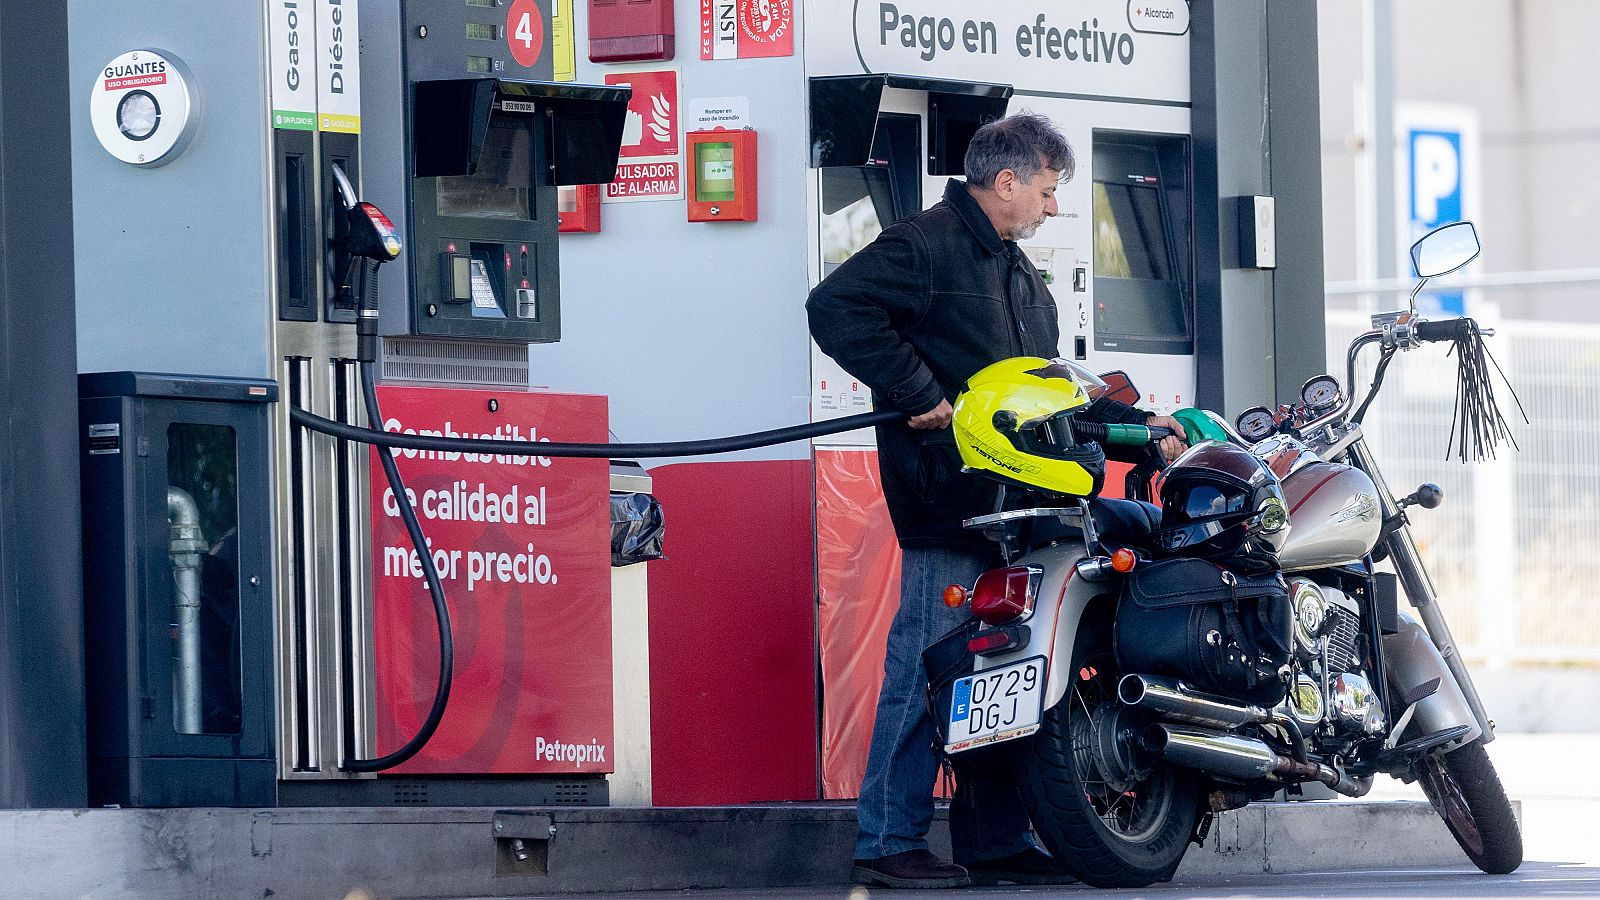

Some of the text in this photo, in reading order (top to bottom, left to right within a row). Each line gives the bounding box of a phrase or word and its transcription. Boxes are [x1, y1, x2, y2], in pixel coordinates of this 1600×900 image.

[515, 12, 533, 48] 4
[703, 0, 710, 54] 21 31 32
[720, 4, 735, 45] NST
[740, 12, 760, 42] SEGURIDAD
[768, 0, 790, 41] ECTADA
[770, 3, 780, 20] 24H
[1144, 7, 1174, 19] Alcorcón
[284, 2, 300, 92] Gasol
[329, 0, 344, 94] Diésel
[879, 3, 1135, 66] Pago en efectivo
[104, 61, 166, 78] GUANTES
[107, 76, 163, 88] USO OBLIGATORIO
[610, 179, 677, 195] DE ALARMA
[1413, 135, 1459, 223] P
[969, 445, 1022, 474] ASTONE
[422, 480, 518, 524] calidad
[524, 486, 546, 525] al
[467, 542, 558, 591] precio.
[971, 665, 1038, 705] 0729
[957, 703, 966, 715] E
[969, 698, 1018, 735] DGJ
[535, 736, 606, 768] Petroprix
